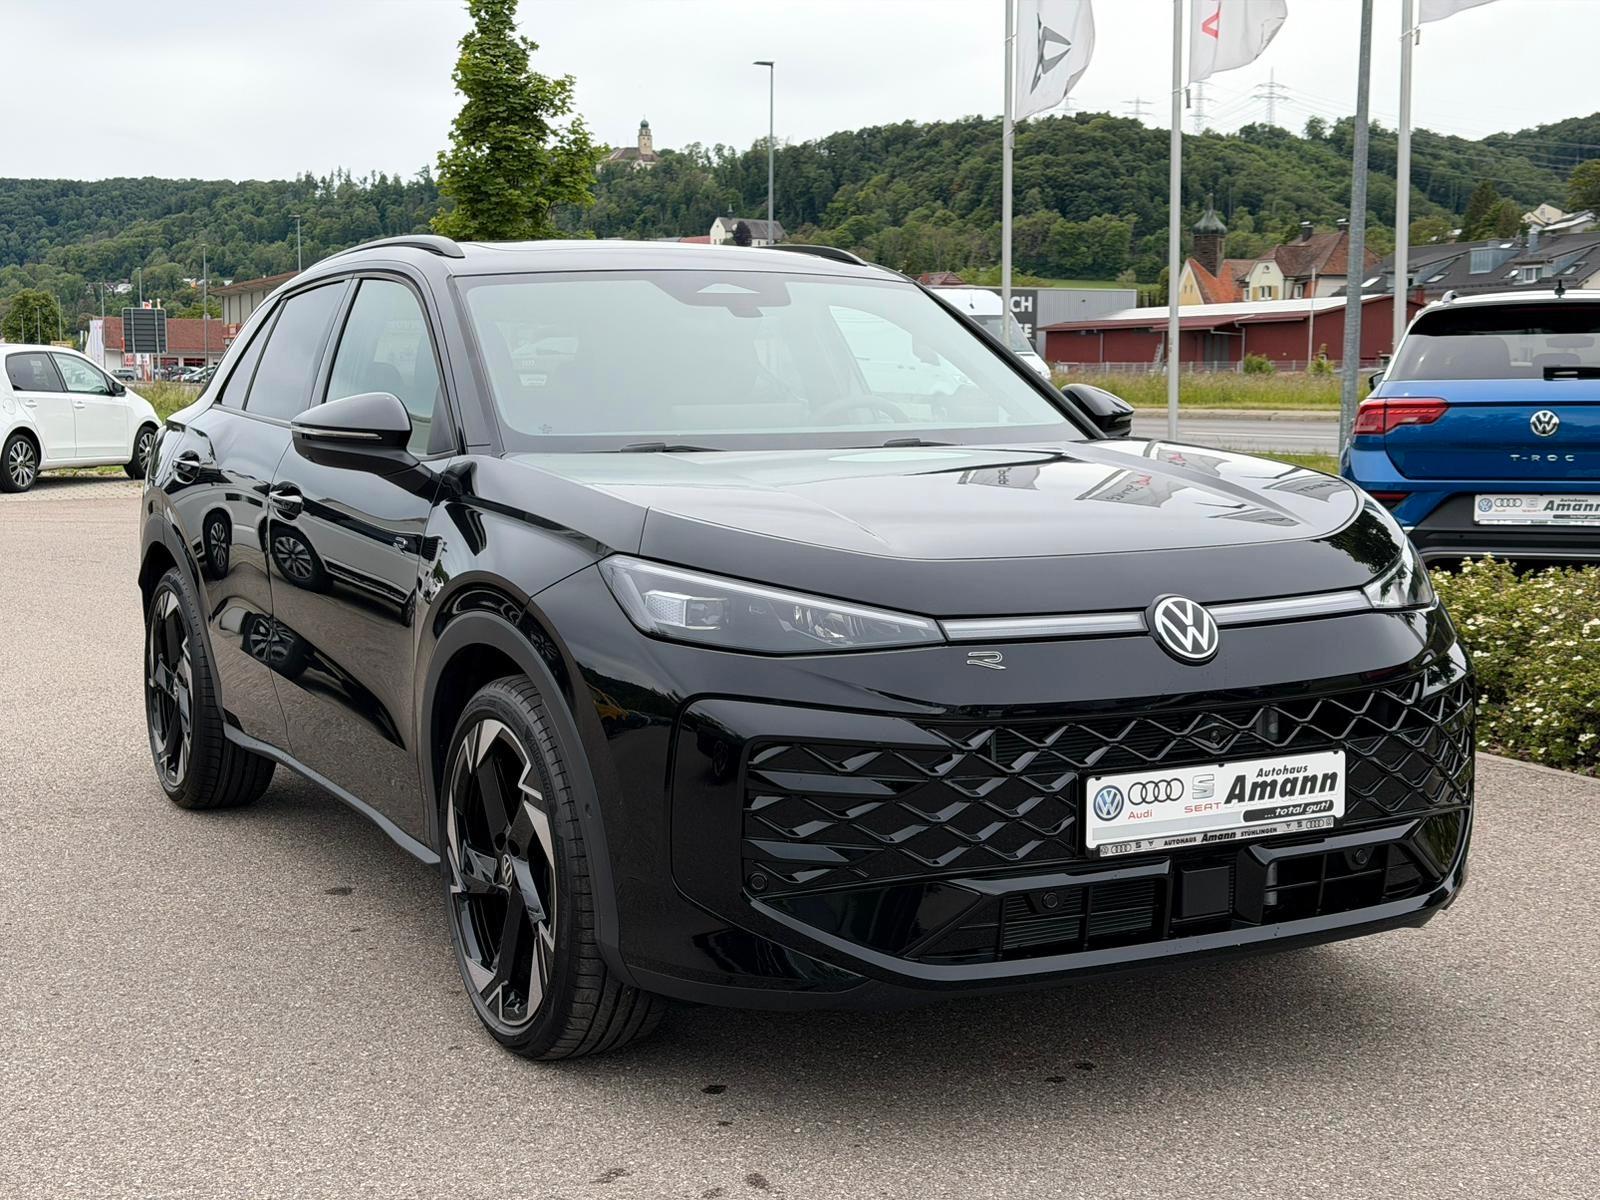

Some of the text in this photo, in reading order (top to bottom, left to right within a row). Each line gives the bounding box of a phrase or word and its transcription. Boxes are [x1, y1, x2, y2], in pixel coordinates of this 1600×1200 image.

[1510, 454, 1575, 462] T-ROC
[1256, 764, 1308, 779] Autohaus
[1224, 771, 1338, 805] Amann
[1184, 801, 1222, 814] SEAT
[1304, 800, 1331, 814] gut!
[1128, 809, 1153, 820] Audi
[1163, 827, 1278, 846] AUTOHAUS Amann STÜHLINGEN
